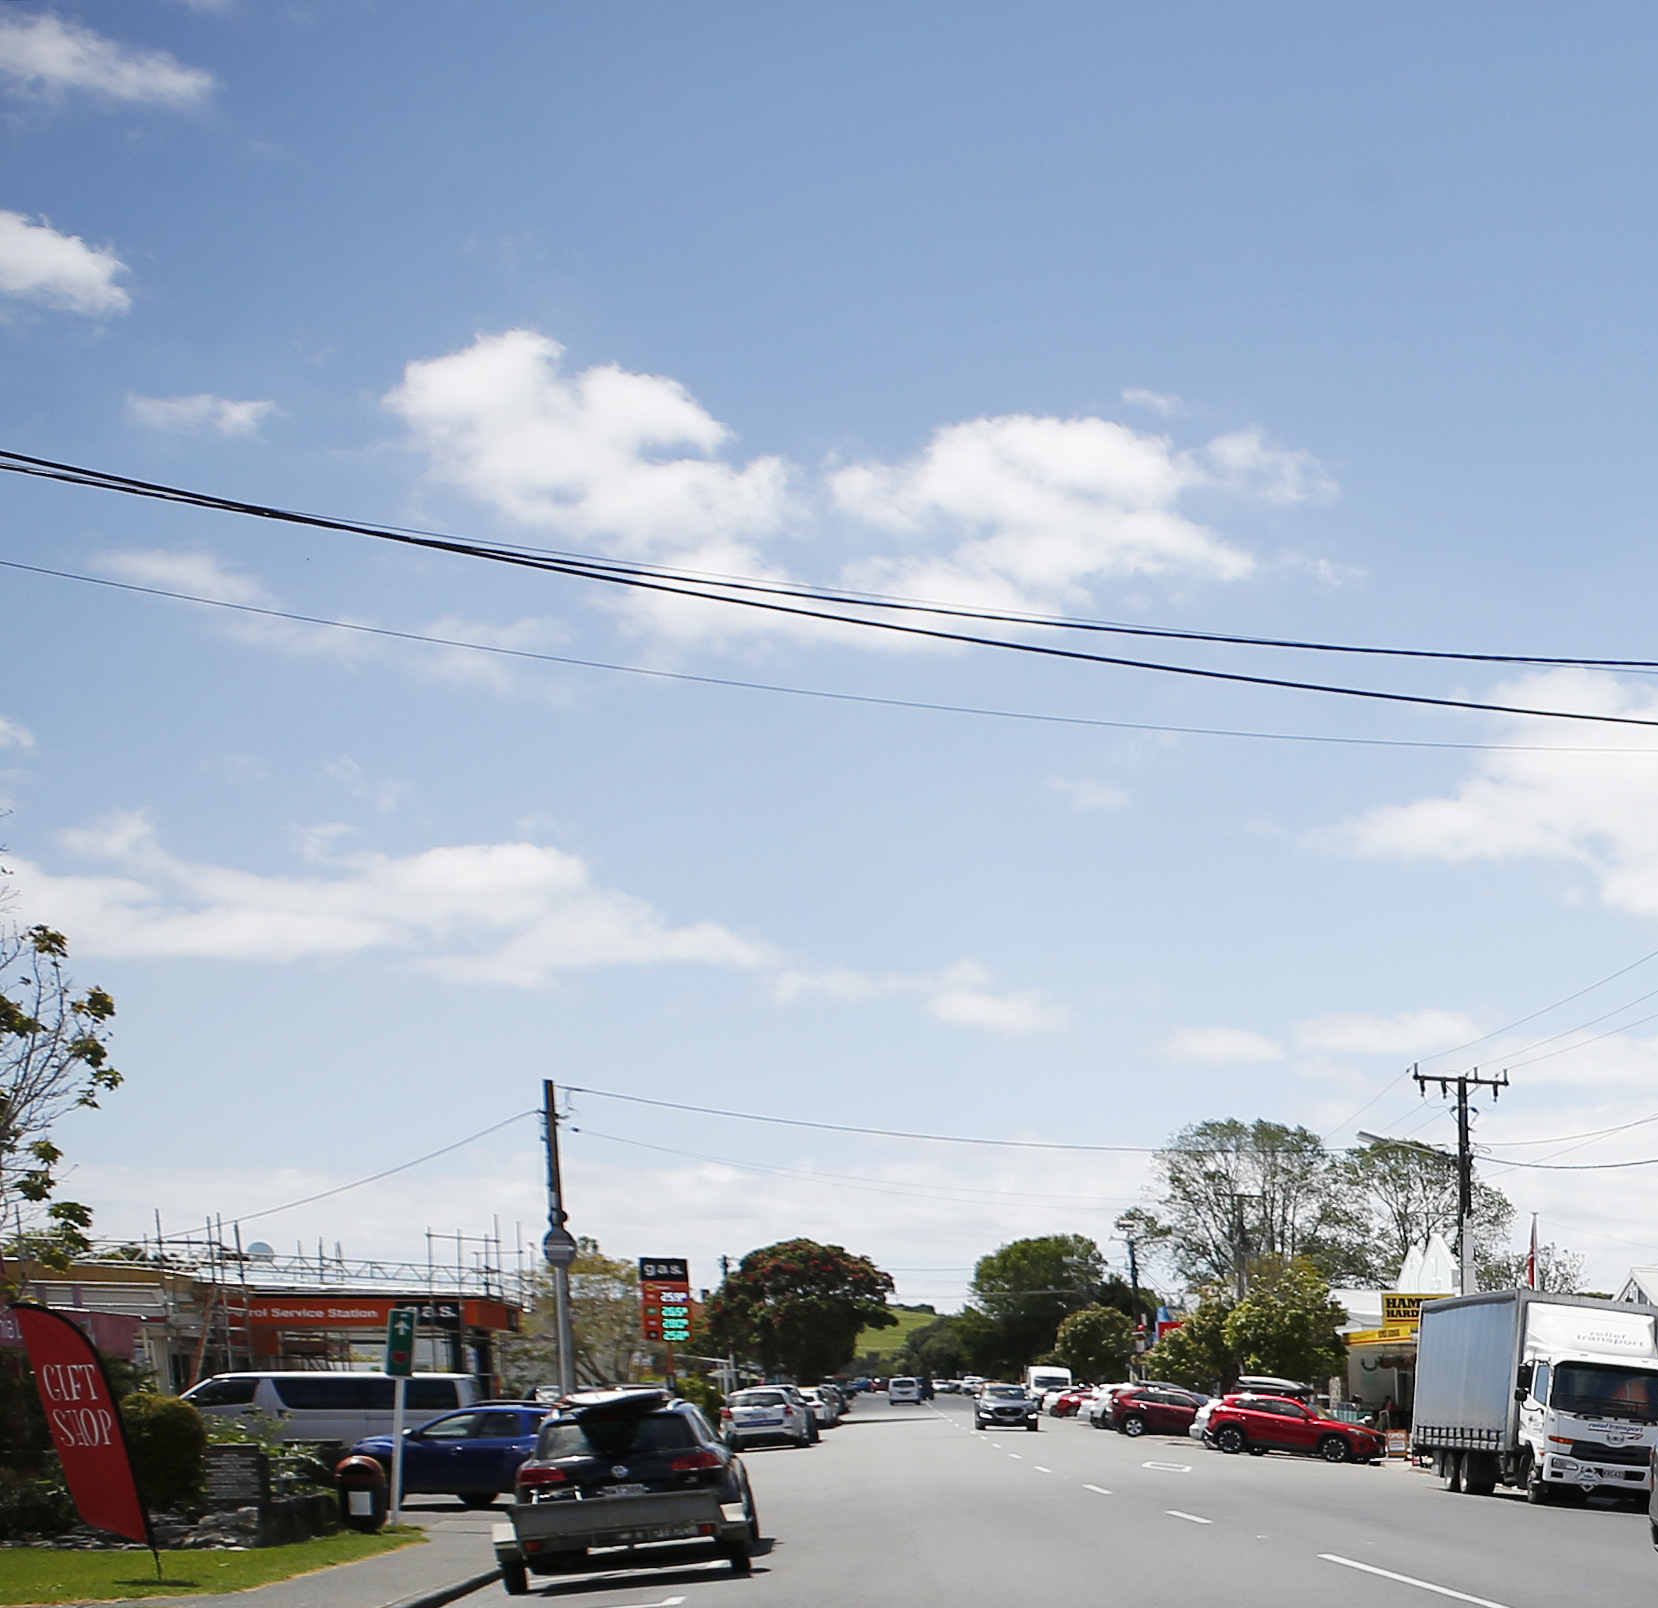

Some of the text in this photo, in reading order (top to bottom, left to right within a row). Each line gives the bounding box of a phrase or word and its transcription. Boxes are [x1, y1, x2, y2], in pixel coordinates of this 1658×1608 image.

[271, 1307, 326, 1318] Service
[327, 1307, 379, 1318] Station
[1576, 1334, 1644, 1347] transport
[43, 1364, 99, 1401] GIFT
[53, 1408, 112, 1447] SHOP
[1609, 1423, 1643, 1433] transport
